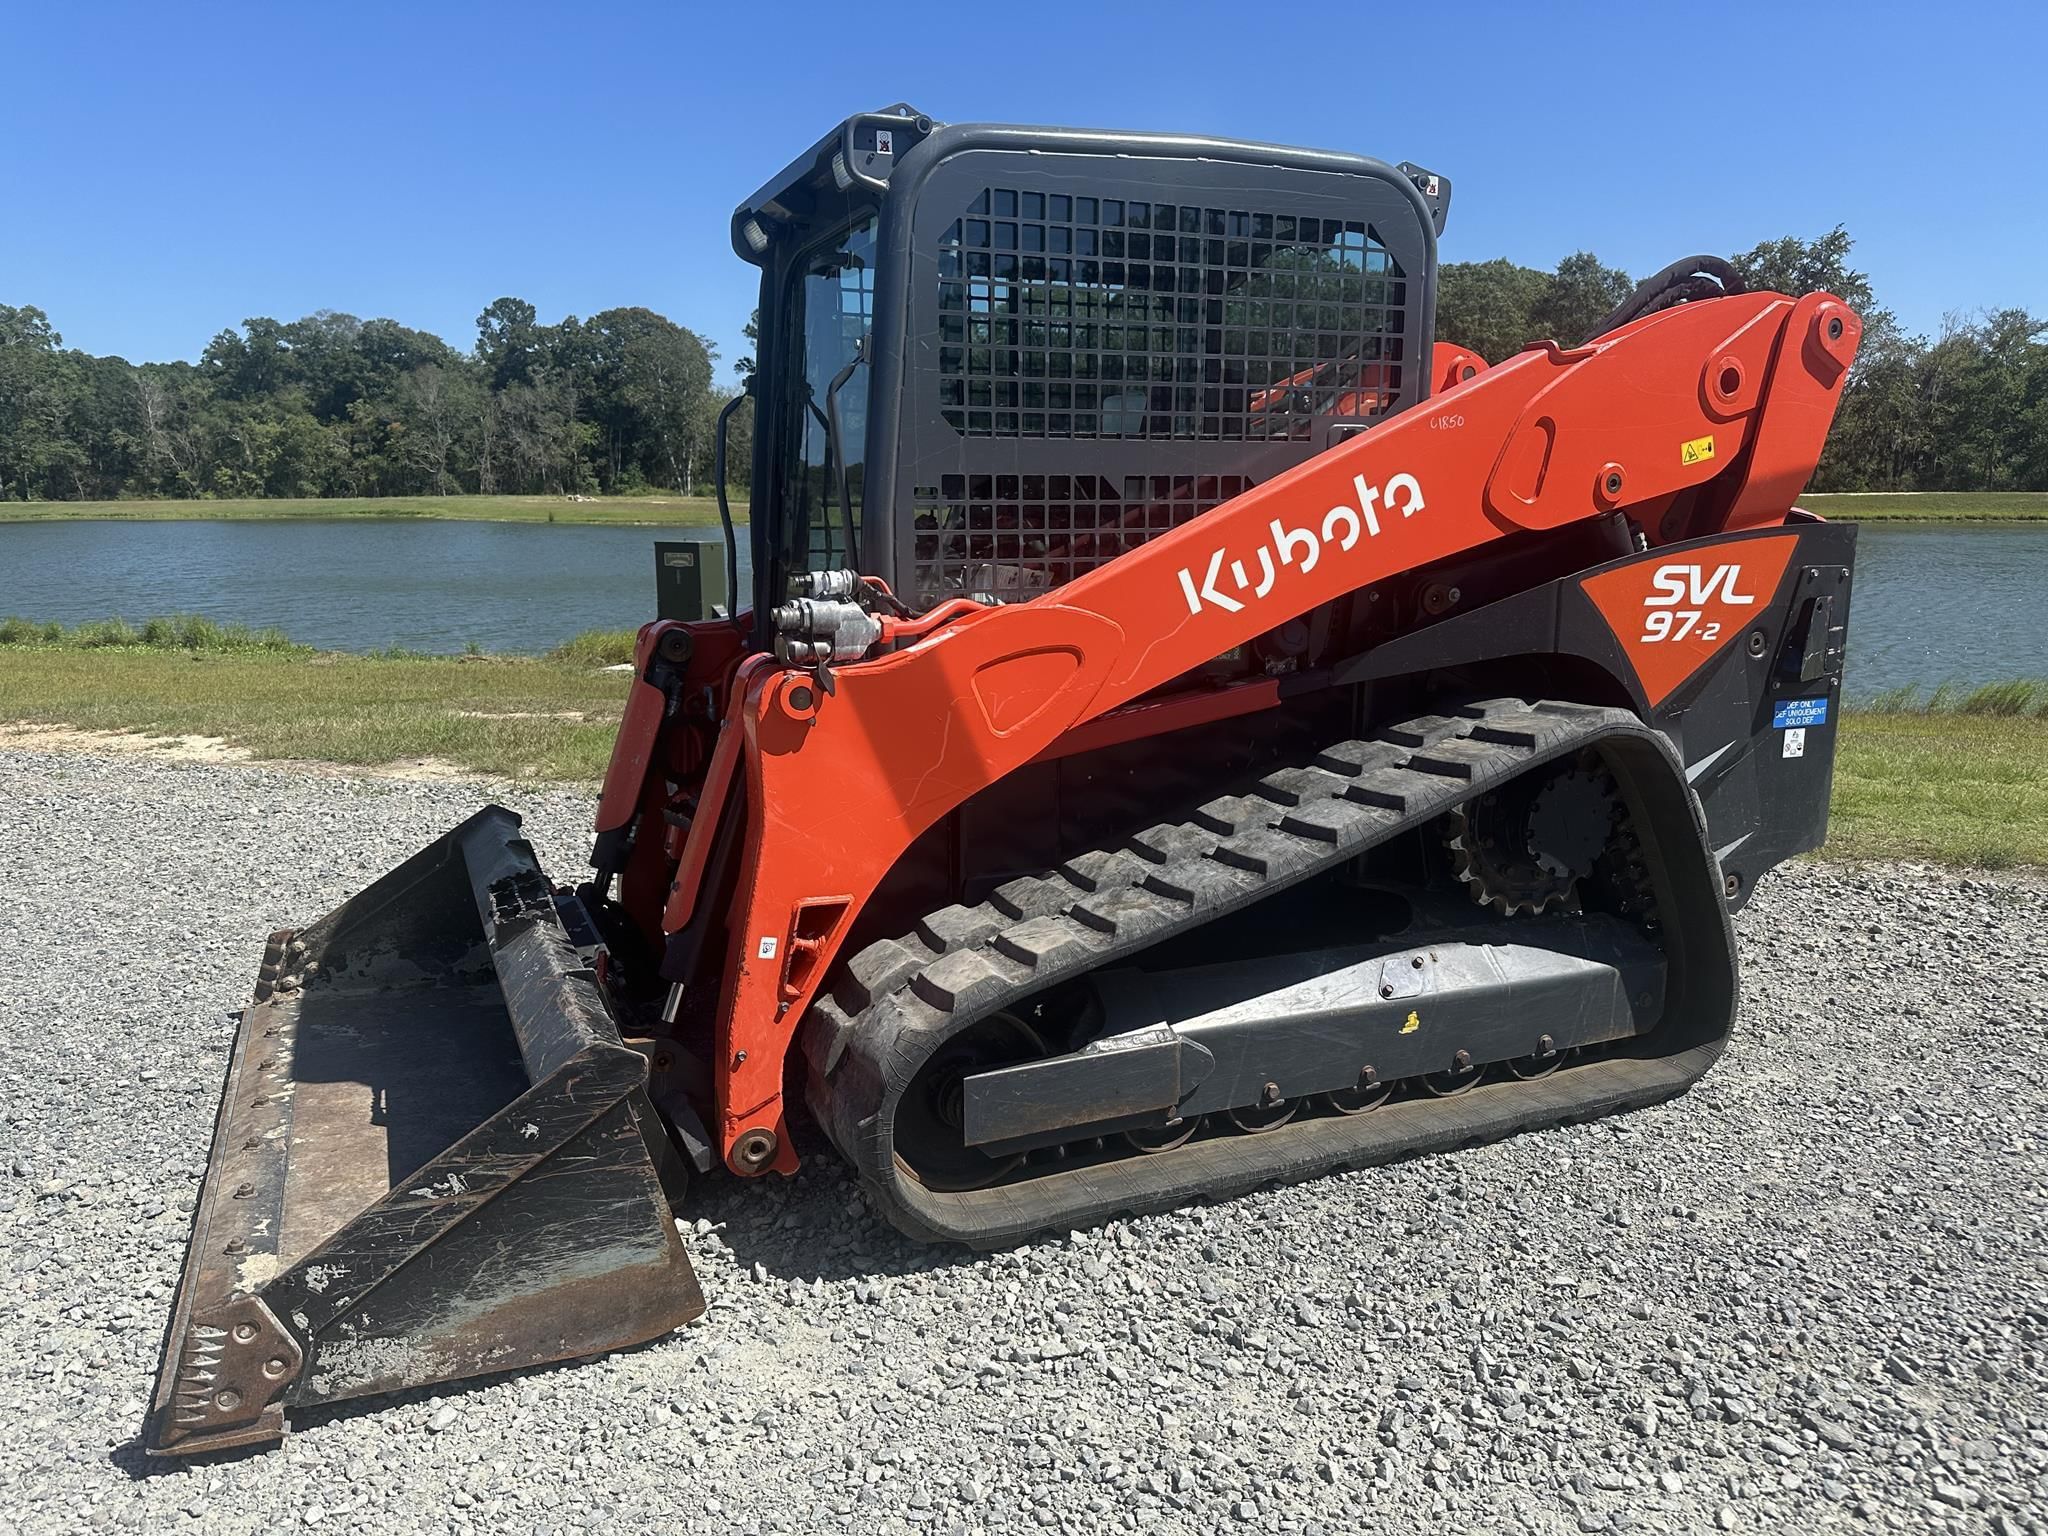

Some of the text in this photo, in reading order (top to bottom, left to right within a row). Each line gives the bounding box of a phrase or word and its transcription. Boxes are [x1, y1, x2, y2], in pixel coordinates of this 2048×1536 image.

[1177, 472, 1425, 615] Kubota
[1643, 564, 1755, 606] SVL
[1640, 610, 1721, 643] 97-2
[1775, 710, 1787, 719] DEF
[1786, 700, 1816, 709] DEF ONLY
[1785, 716, 1815, 725] SOLO DEF
